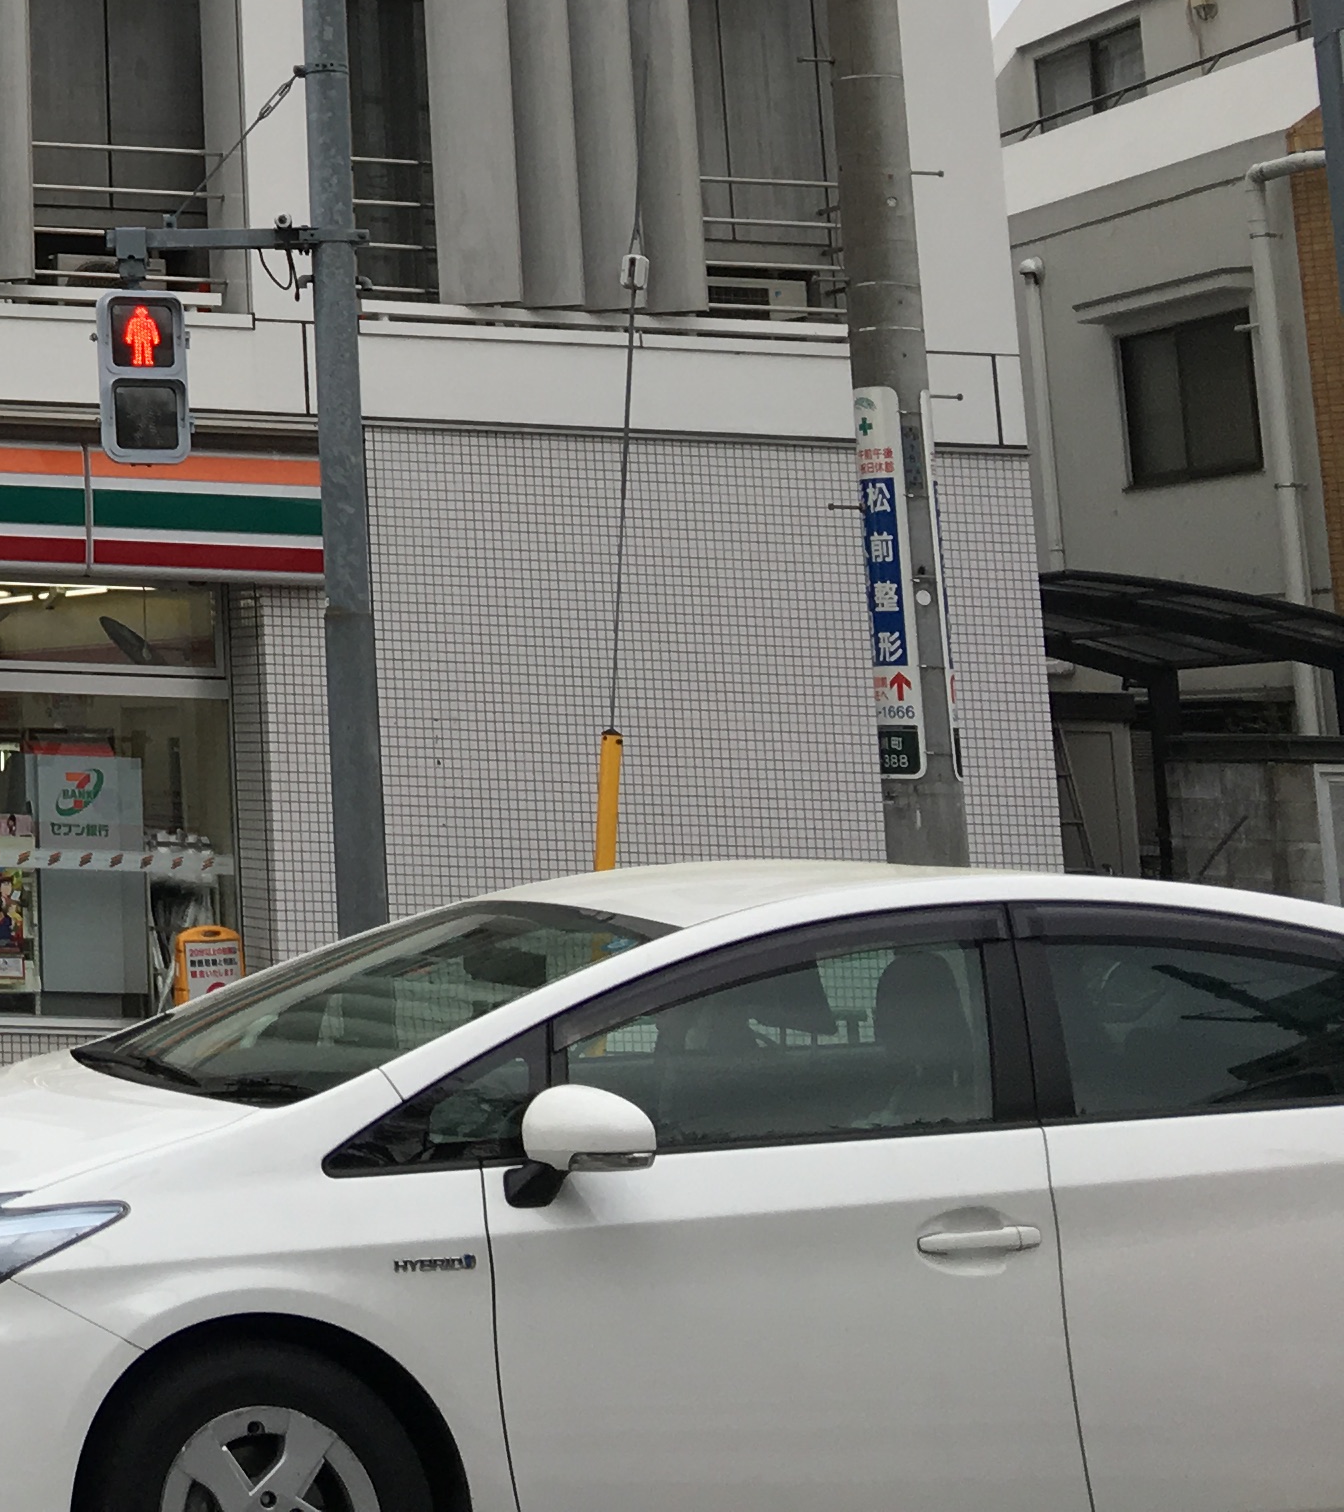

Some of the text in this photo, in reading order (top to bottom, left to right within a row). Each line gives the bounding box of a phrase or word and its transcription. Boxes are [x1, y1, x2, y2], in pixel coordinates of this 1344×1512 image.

[866, 482, 903, 663] 松前整形
[50, 822, 110, 838] セブン銀行
[393, 1255, 465, 1273] HYBRID
